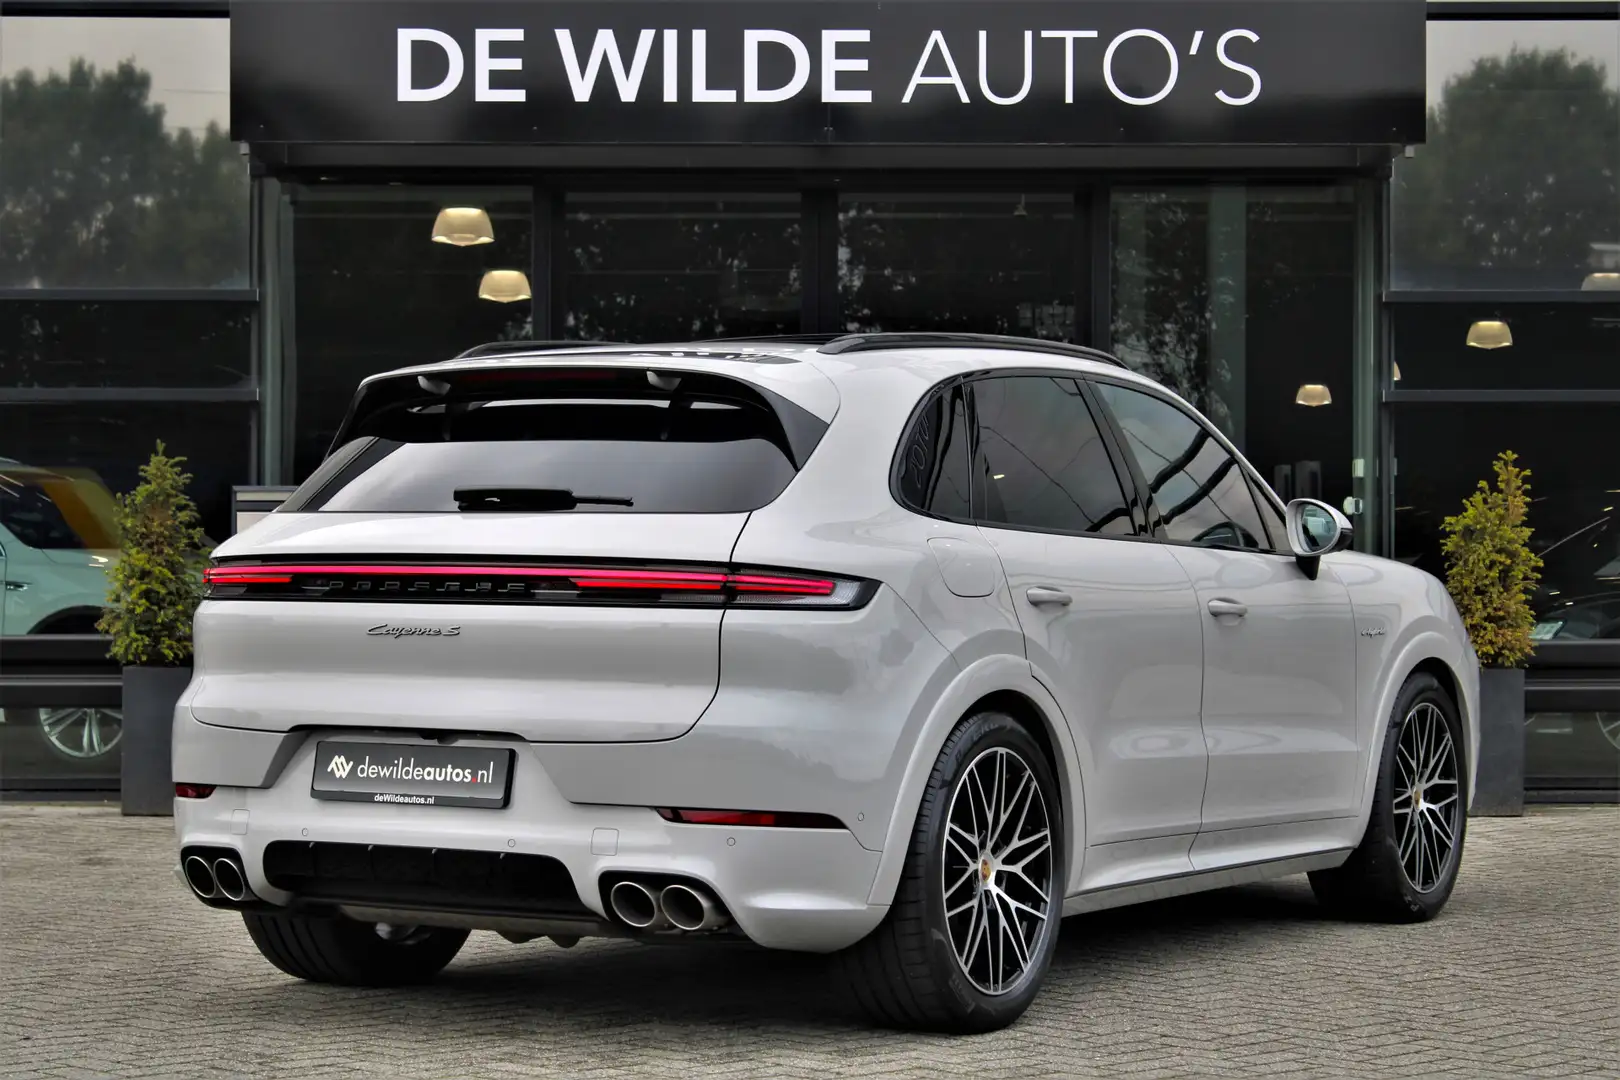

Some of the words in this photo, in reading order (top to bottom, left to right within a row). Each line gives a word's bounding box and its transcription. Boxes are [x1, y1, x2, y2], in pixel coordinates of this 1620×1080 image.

[397, 28, 527, 103] DE
[554, 28, 873, 103] WILDE
[901, 28, 1262, 106] AUTO'S
[328, 580, 526, 593] PORSCHE
[366, 623, 442, 639] Cayenne
[442, 625, 461, 636] S
[356, 755, 494, 784] dewildeautos.nl
[374, 793, 435, 805] deWildeautos.nl
